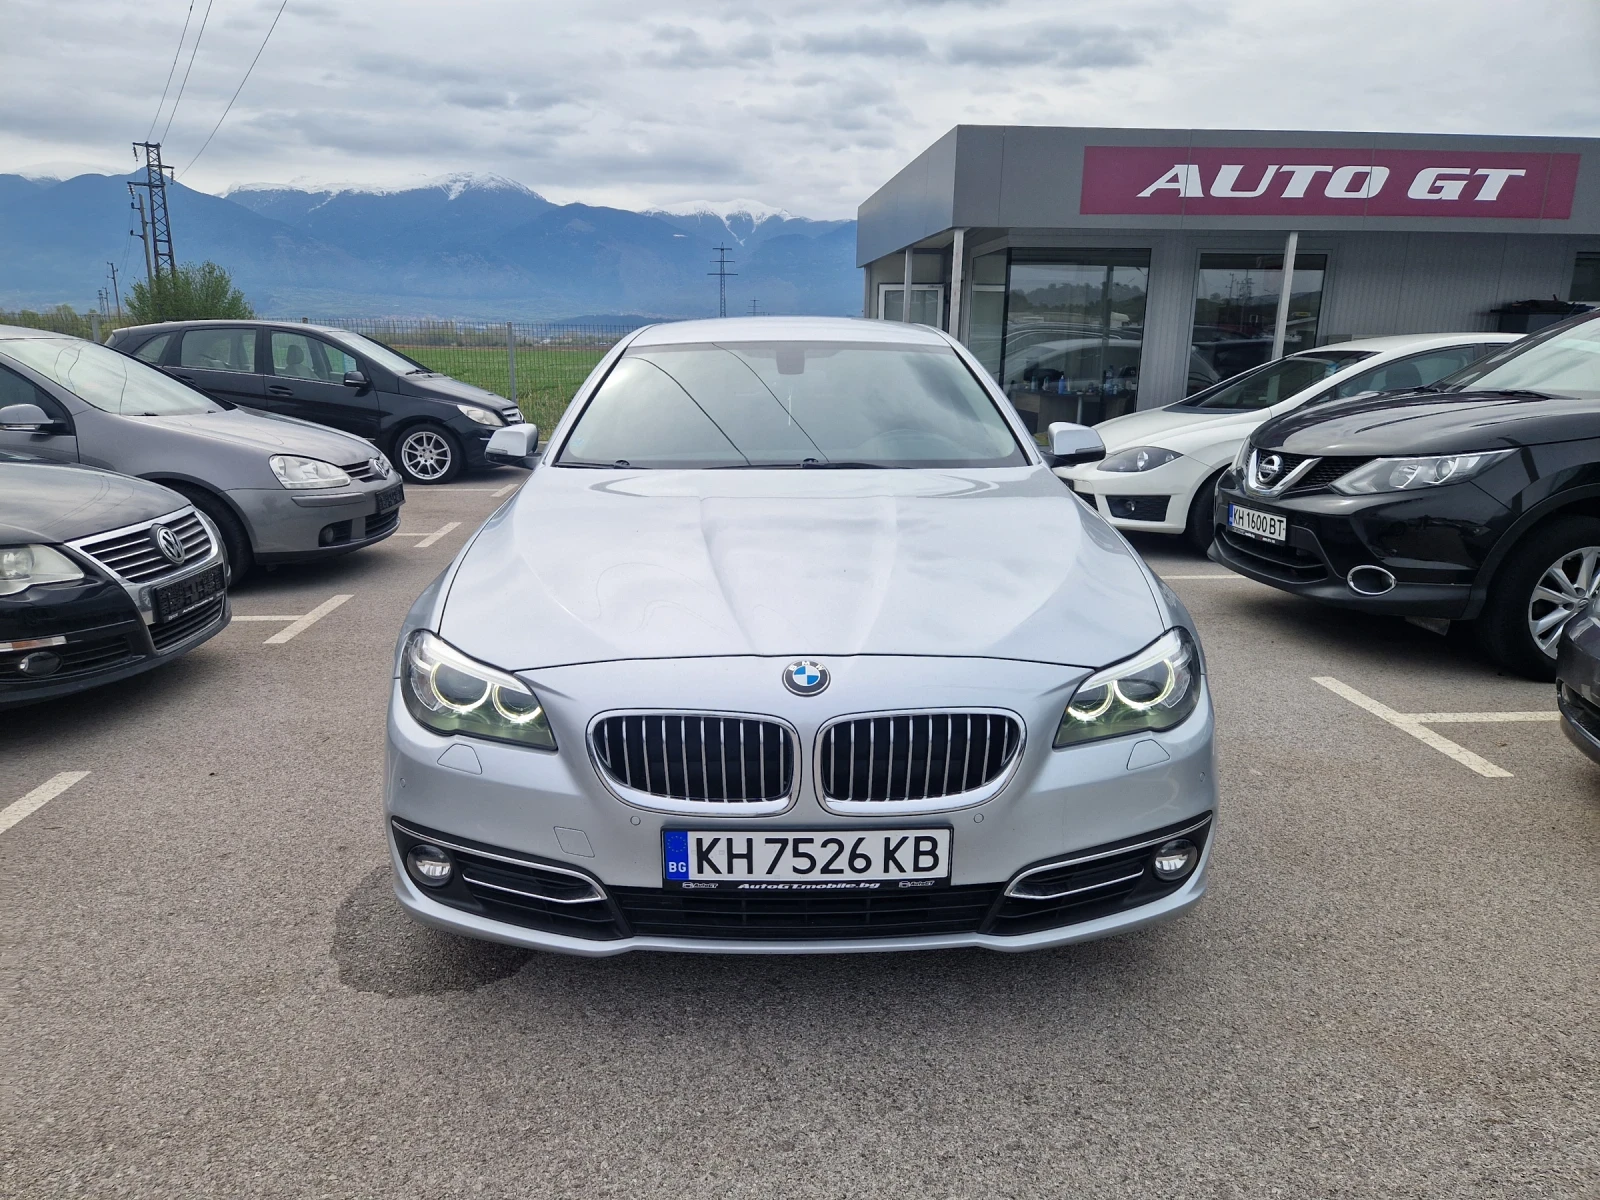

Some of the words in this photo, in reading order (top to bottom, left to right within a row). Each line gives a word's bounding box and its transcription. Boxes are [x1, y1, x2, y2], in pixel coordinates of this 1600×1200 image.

[1136, 163, 1390, 199] AUTO
[1406, 167, 1526, 201] GT
[1246, 511, 1267, 532] 1600
[1269, 517, 1284, 537] BT
[788, 660, 826, 671] BMW
[668, 861, 687, 873] BG
[696, 837, 754, 875] KH
[764, 837, 872, 874] 7526
[883, 835, 940, 874] KB
